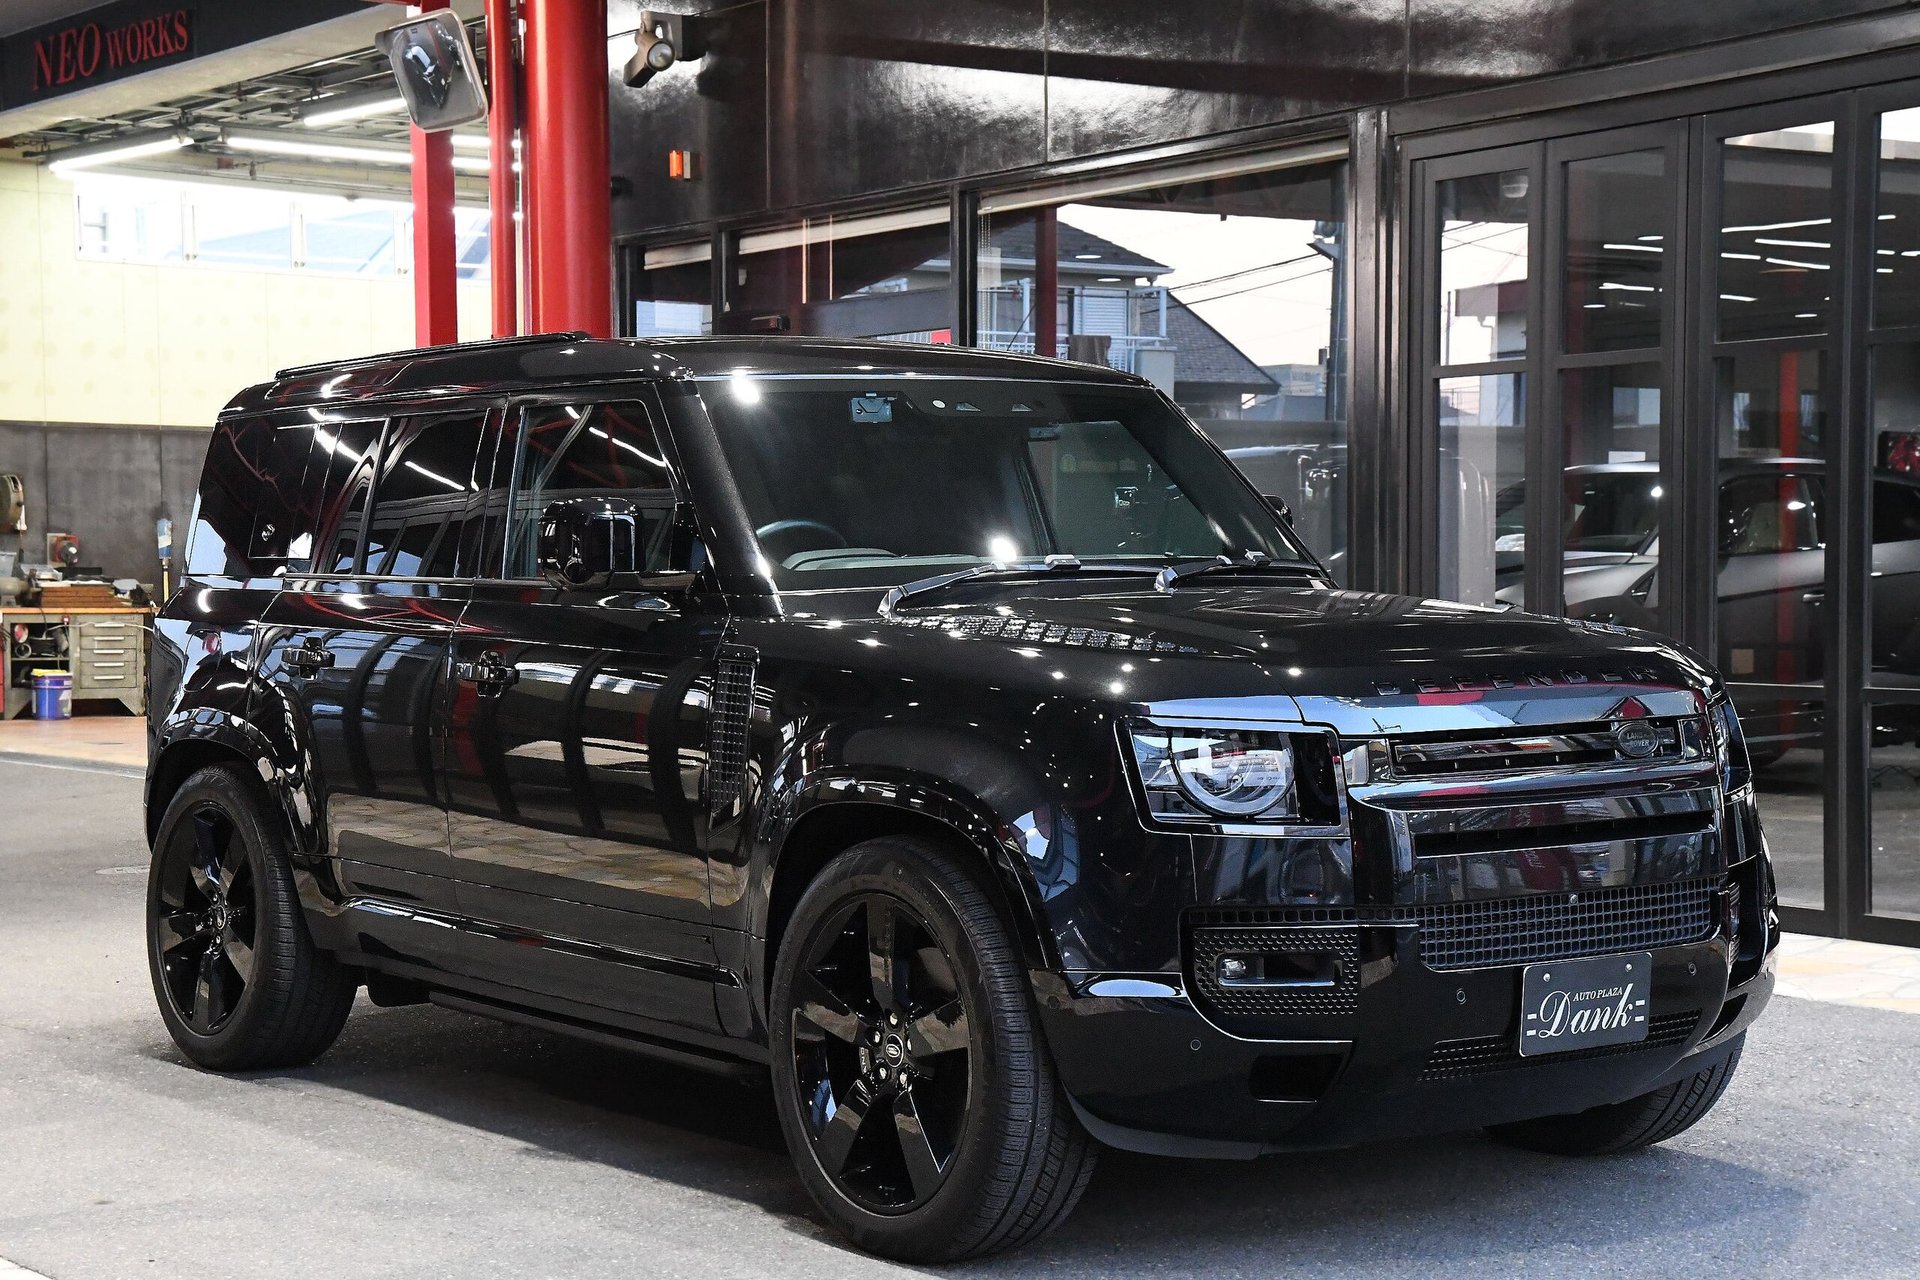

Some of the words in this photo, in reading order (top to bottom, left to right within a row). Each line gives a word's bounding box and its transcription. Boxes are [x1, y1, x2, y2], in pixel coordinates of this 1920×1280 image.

[31, 22, 101, 92] NEO
[105, 10, 188, 68] WORKS
[1371, 665, 1659, 696] DEFENDER
[1538, 983, 1633, 1038] Dank
[1572, 990, 1597, 1002] AUTO
[1596, 986, 1623, 999] PLAZA
